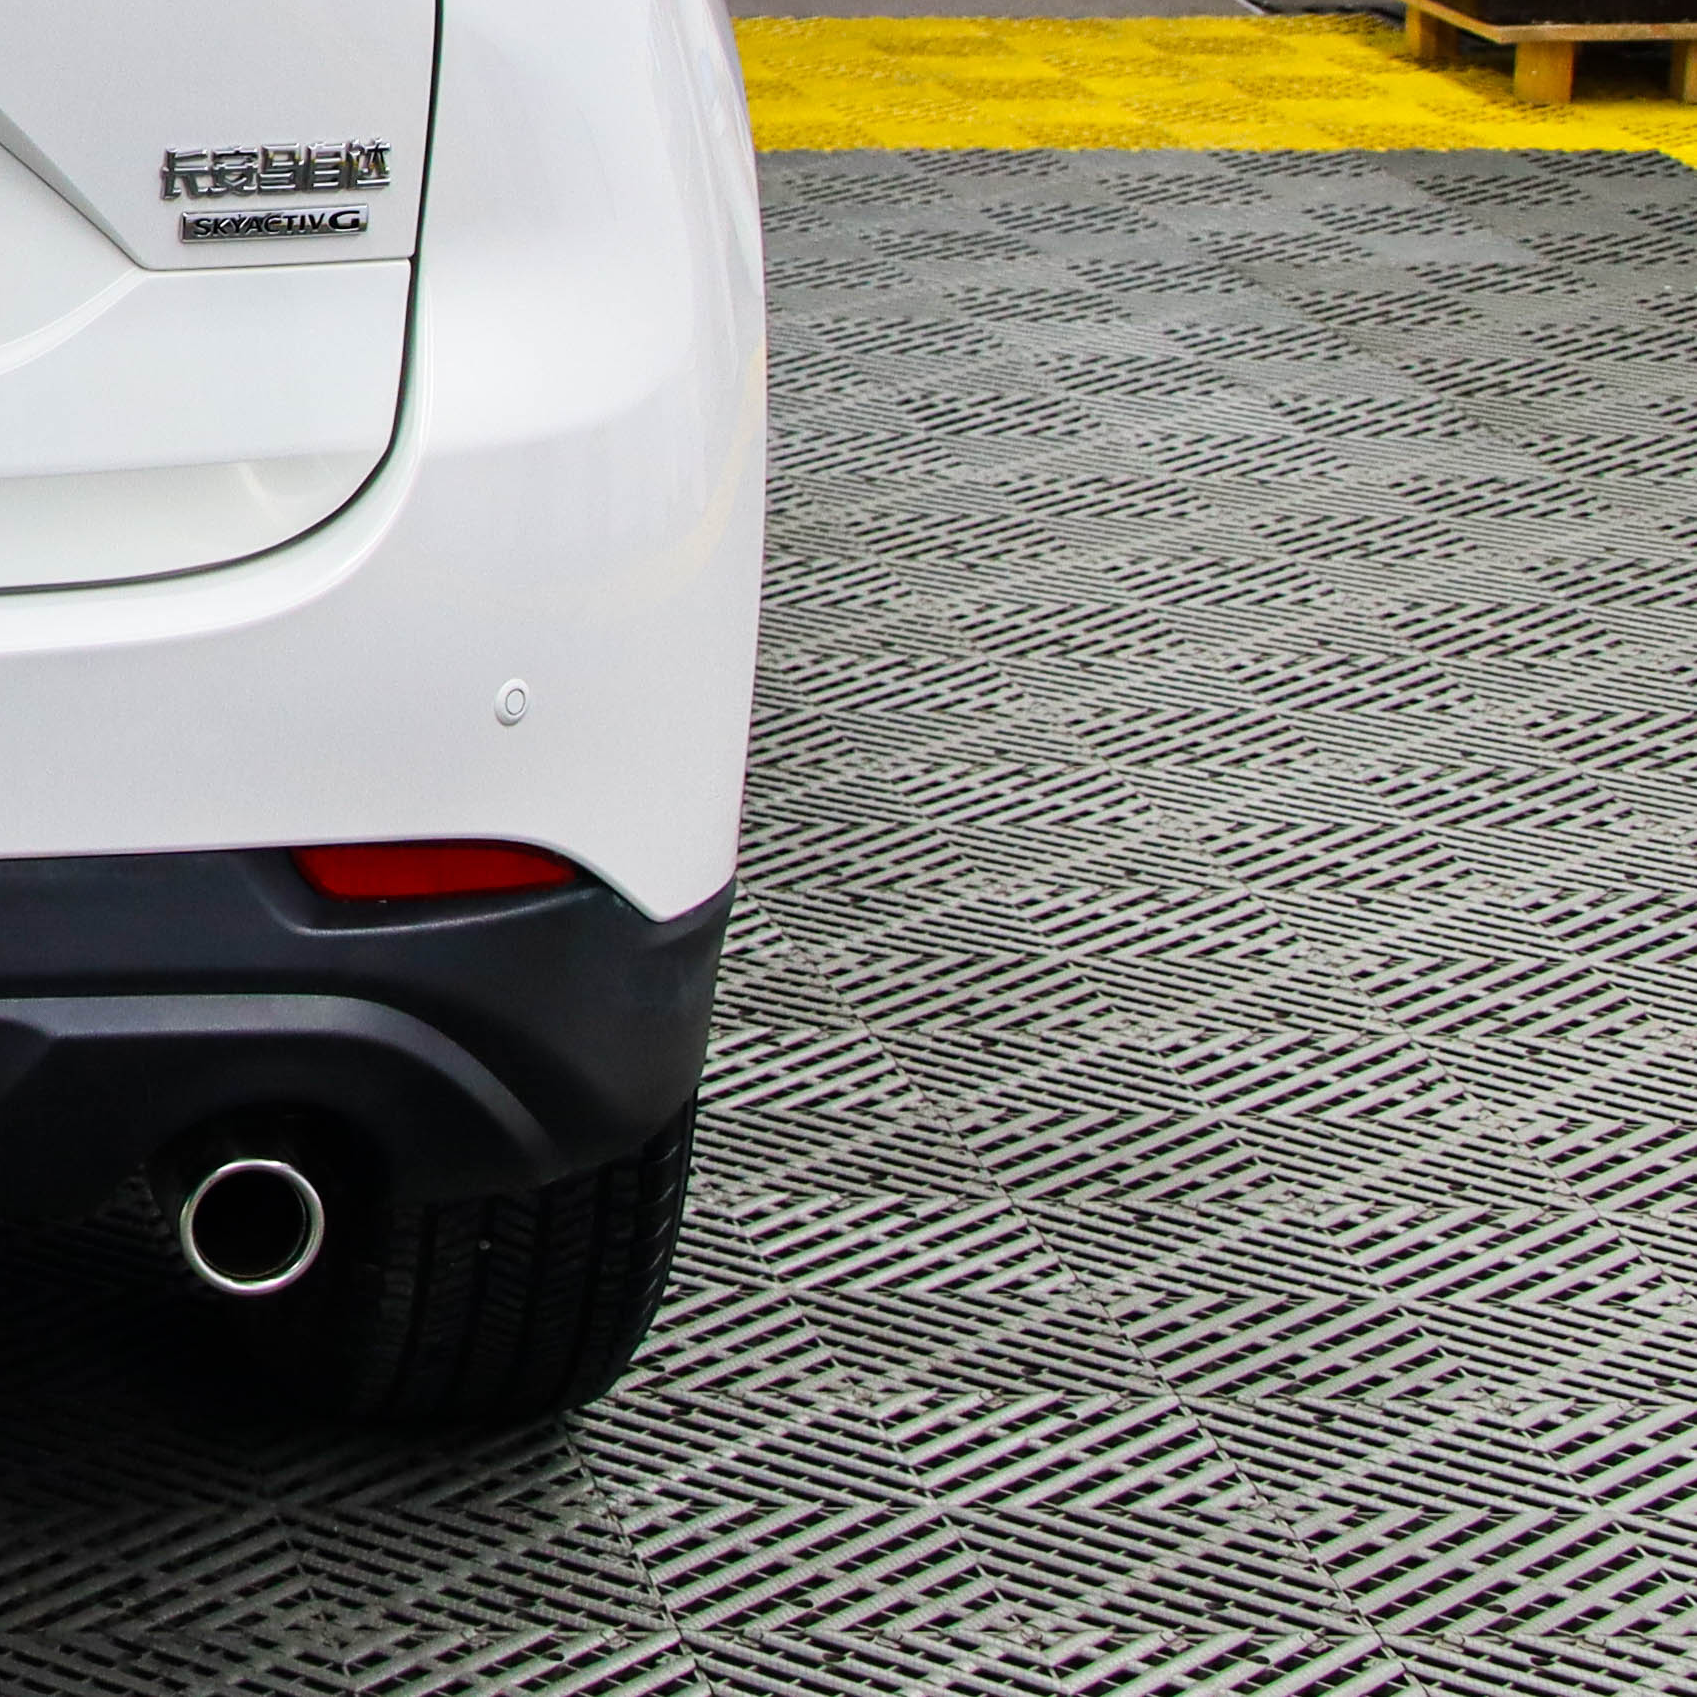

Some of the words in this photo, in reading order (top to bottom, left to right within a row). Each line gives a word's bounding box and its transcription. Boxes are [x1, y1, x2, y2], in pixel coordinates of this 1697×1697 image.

[160, 136, 392, 201] 长安马自达
